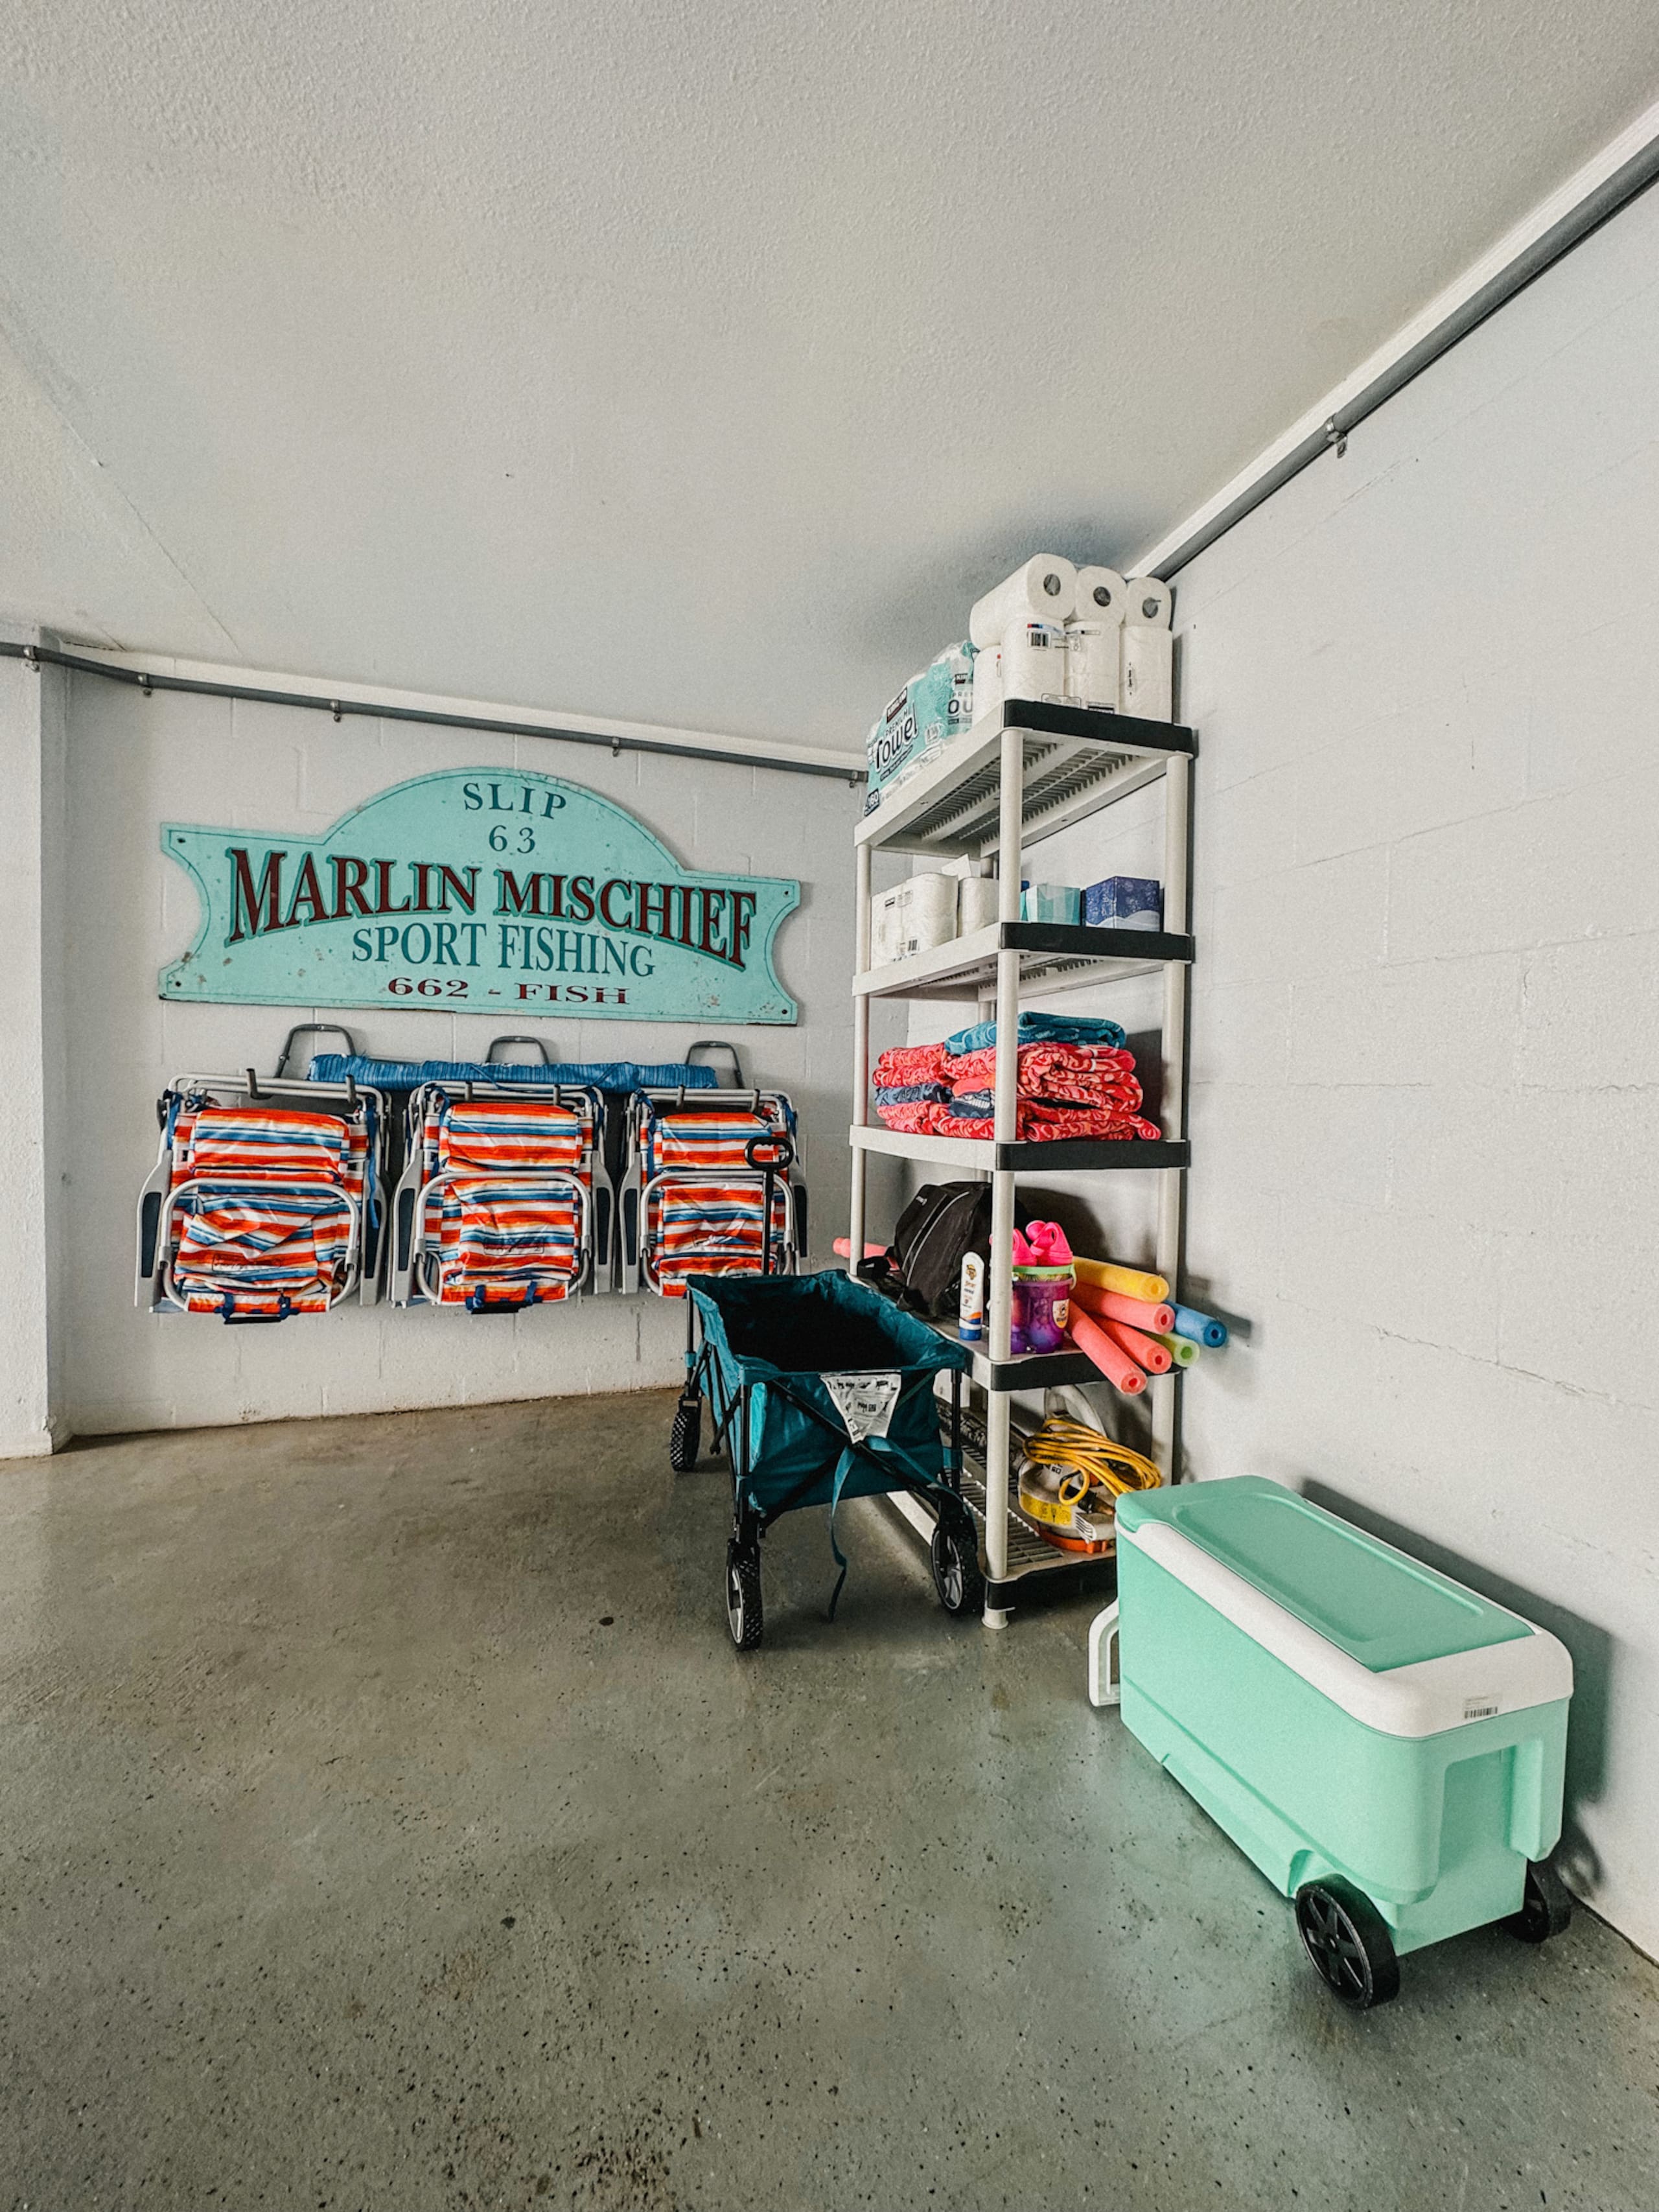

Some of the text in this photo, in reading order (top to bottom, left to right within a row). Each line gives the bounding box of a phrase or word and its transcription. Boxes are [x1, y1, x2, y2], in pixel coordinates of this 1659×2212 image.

[876, 699, 918, 771] Towel
[463, 782, 566, 820] SLIP
[489, 824, 535, 854] 63
[225, 846, 757, 972] MARLIN MISCHIEF
[352, 922, 656, 977] SPORT FISHING
[388, 977, 469, 999] 662
[515, 983, 630, 1005] FISH
